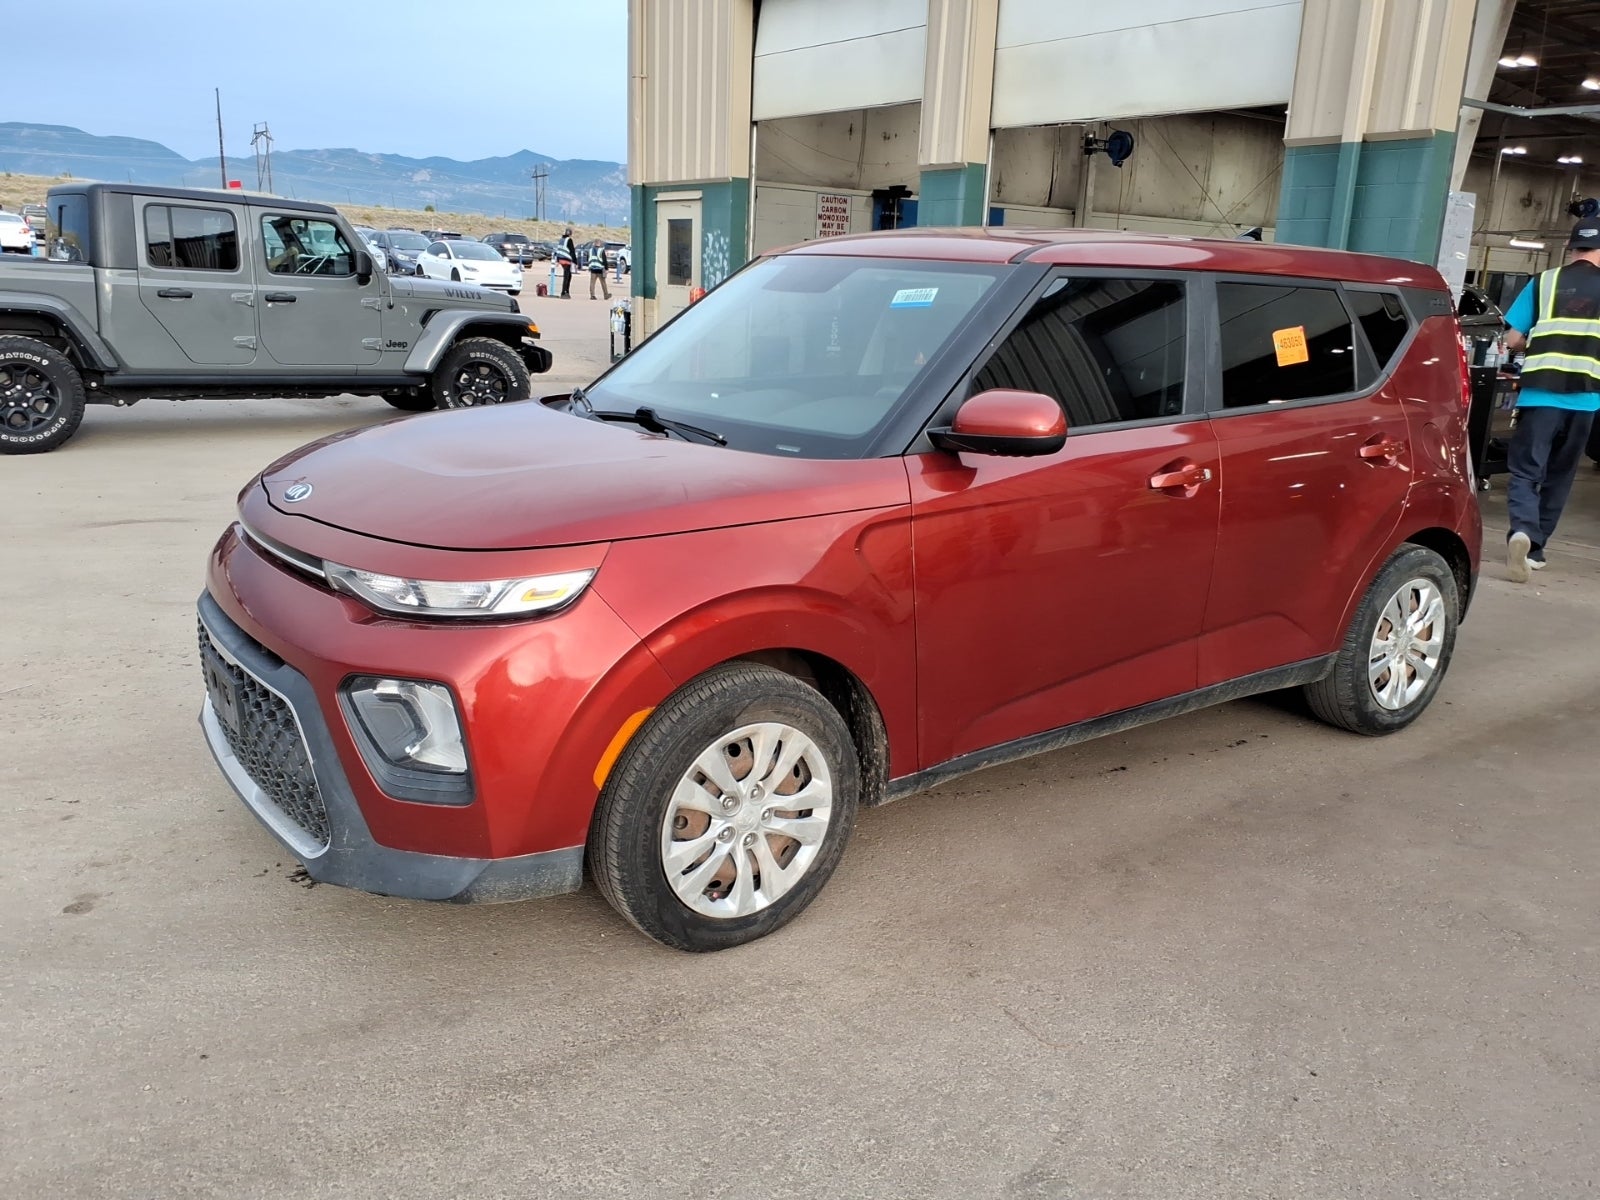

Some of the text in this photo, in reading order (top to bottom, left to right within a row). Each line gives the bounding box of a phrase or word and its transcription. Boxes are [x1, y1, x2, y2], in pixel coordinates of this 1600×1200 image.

[821, 196, 848, 204] CAUTION
[821, 206, 847, 214] CARBON
[817, 213, 849, 222] MONOXIDE
[443, 288, 482, 299] WILLYS
[386, 339, 408, 349] Jeep
